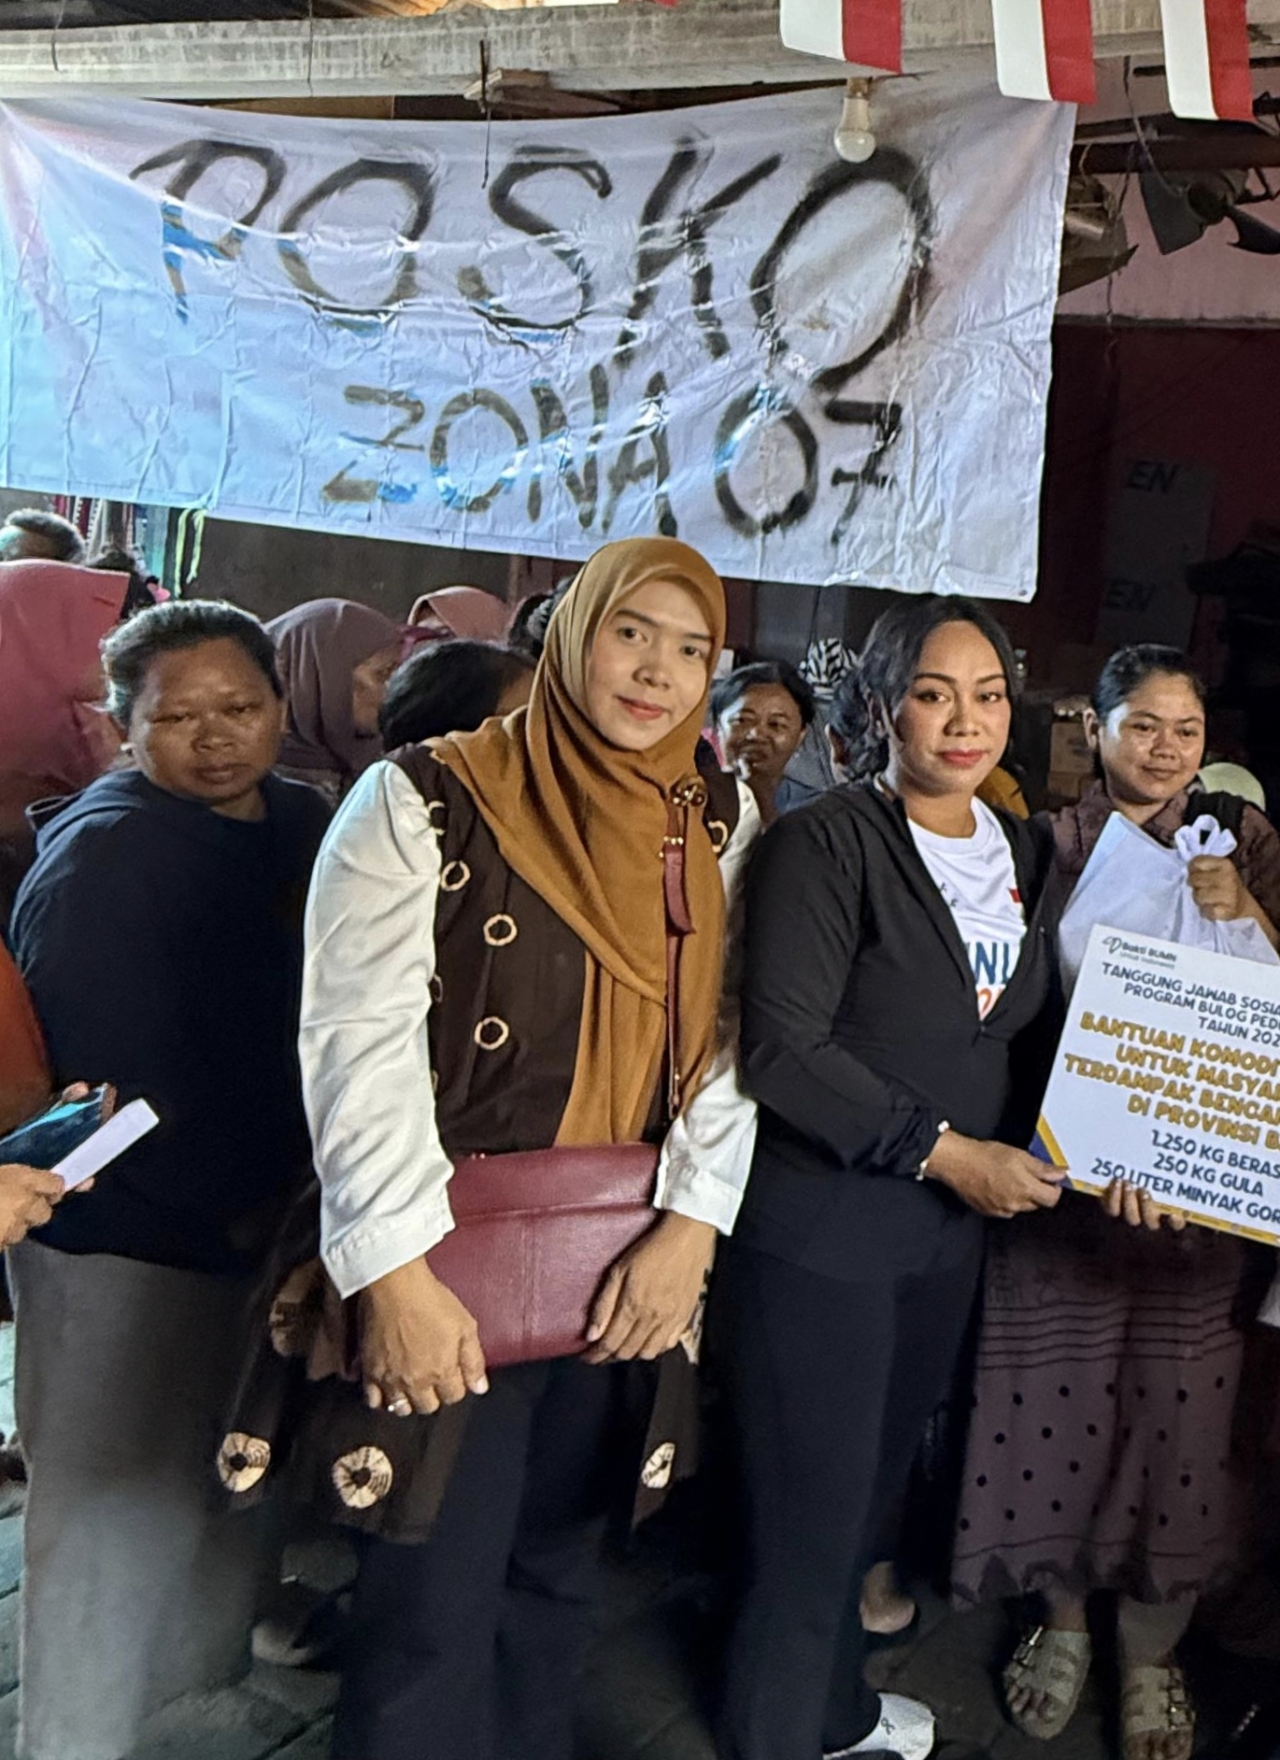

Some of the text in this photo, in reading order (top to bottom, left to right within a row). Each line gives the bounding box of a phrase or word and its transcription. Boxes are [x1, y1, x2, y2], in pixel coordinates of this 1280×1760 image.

[129, 136, 932, 391] POSKO
[319, 365, 902, 544] ZONA 07
[1102, 961, 1182, 992] TANGGUNG
[1184, 983, 1236, 1005] JAWAB
[1123, 982, 1195, 1009] PROGRAM
[1197, 1000, 1247, 1022] BULOG
[1079, 1011, 1186, 1053] BANTUAN
[1198, 1015, 1248, 1039] TAHUN
[1064, 1052, 1195, 1103] TERDAMPAK
[1115, 1042, 1193, 1078] UNTUK
[1127, 1093, 1151, 1116] DI
[1153, 1101, 1261, 1145] PROVINSI
[1151, 1129, 1196, 1155] 1.250
[1198, 1144, 1224, 1163] KG
[1090, 1157, 1125, 1179] 250
[1128, 1169, 1173, 1194] LITER
[1176, 1182, 1243, 1213] MINYAK
[1152, 1152, 1263, 1197] 250 KG GULA
